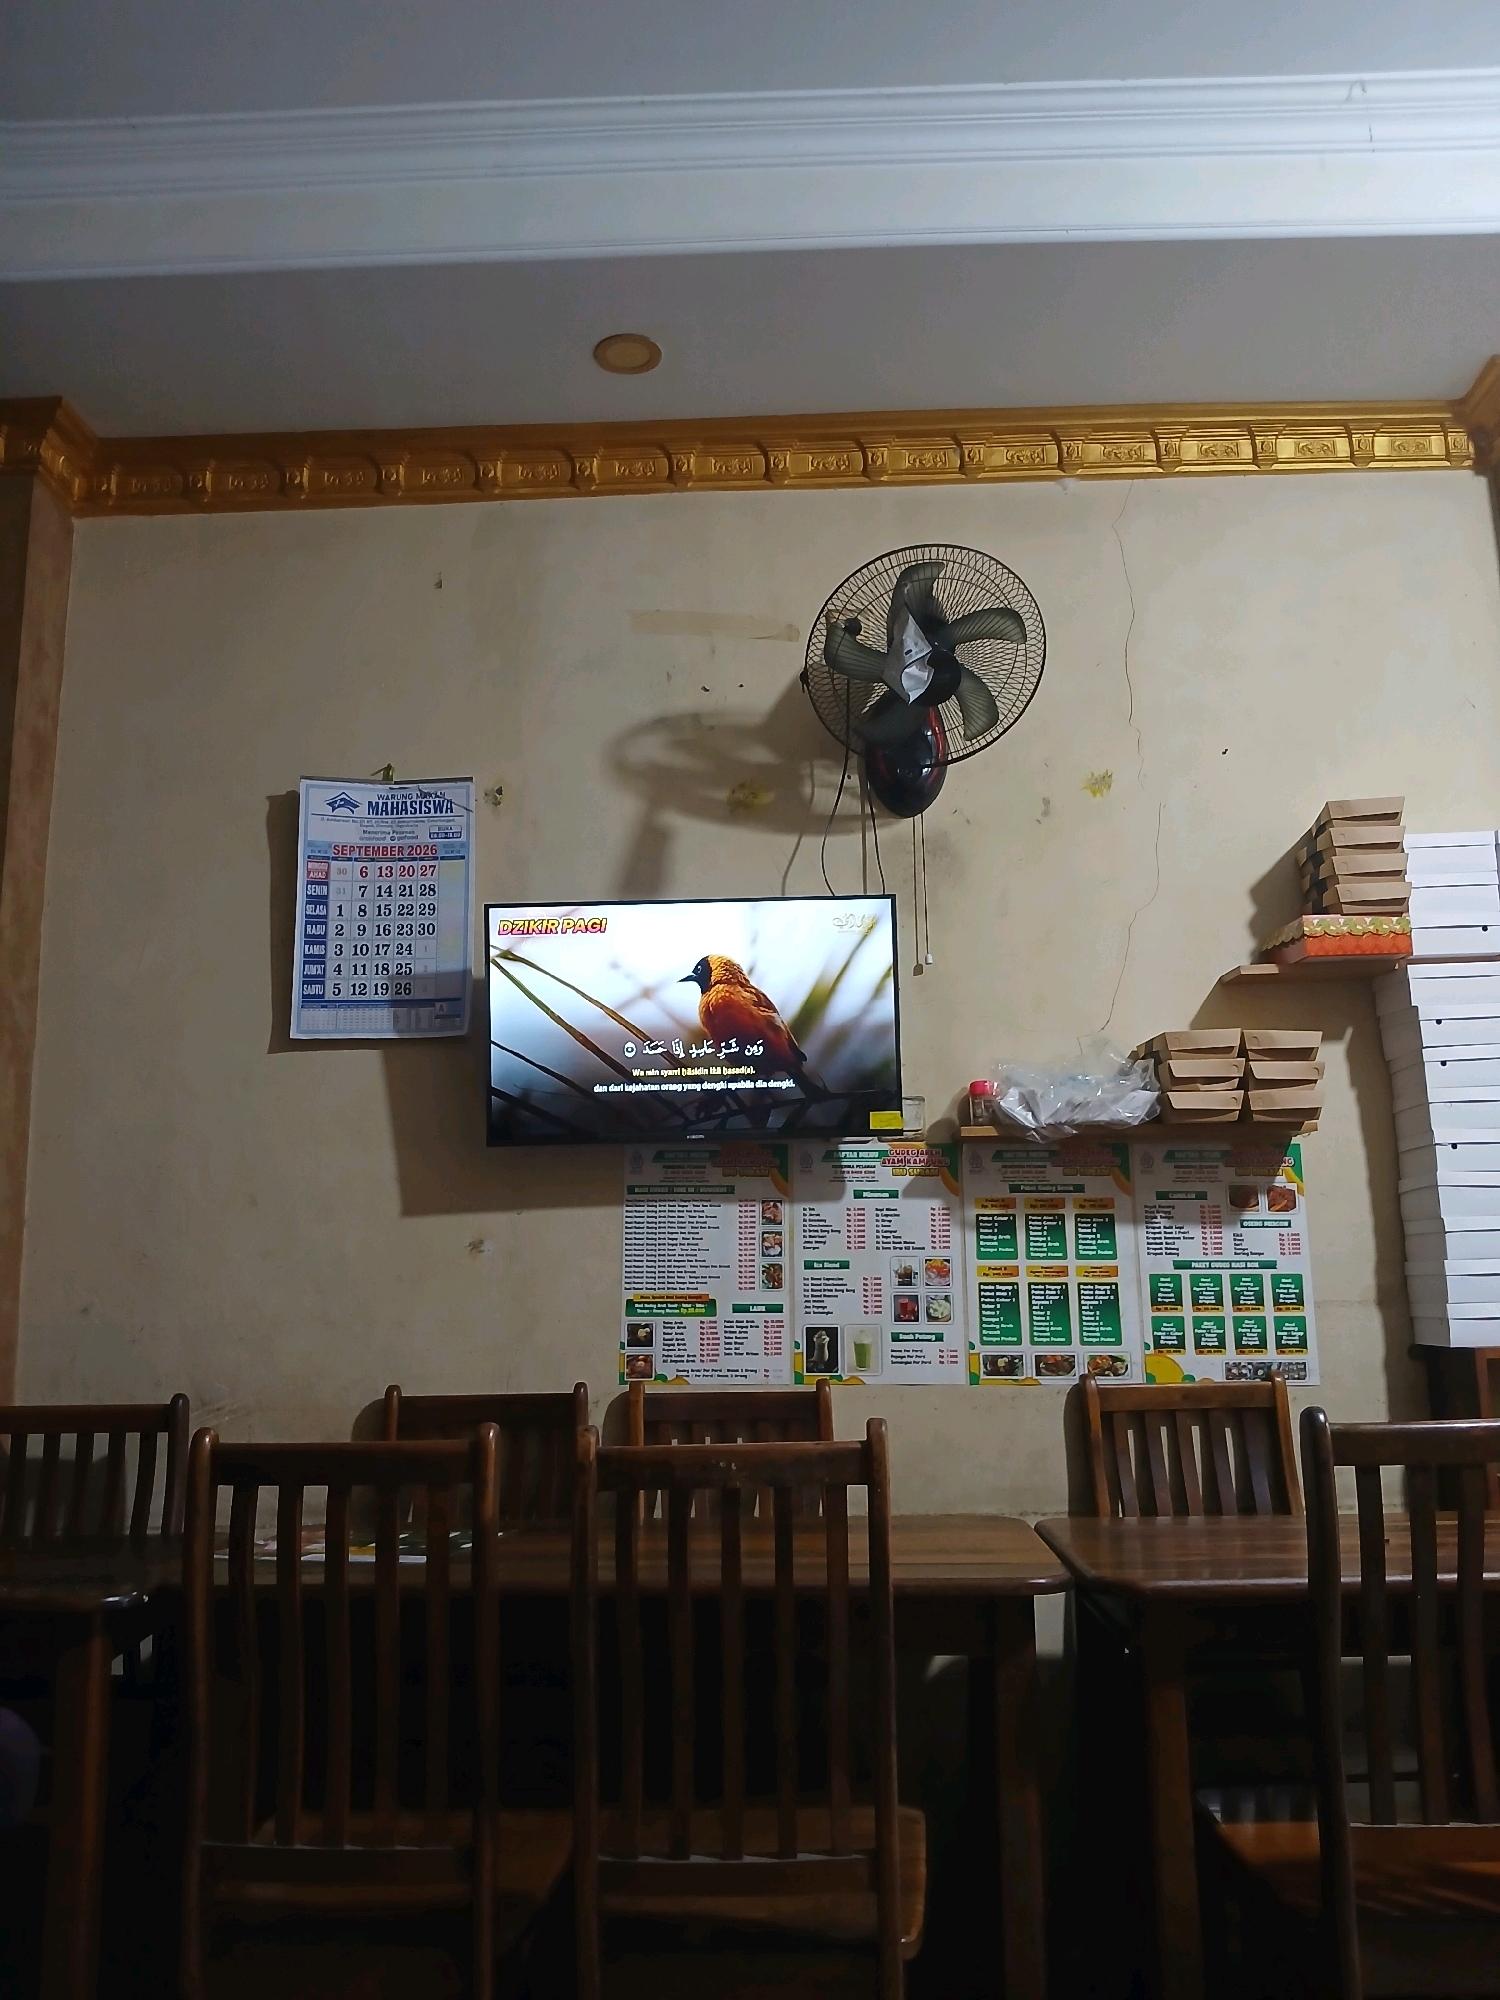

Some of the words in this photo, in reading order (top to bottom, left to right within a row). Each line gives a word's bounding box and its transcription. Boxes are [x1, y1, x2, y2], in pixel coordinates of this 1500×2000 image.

[377, 793, 414, 801] WARUNG
[367, 798, 454, 816] MAHASISWA
[332, 844, 405, 857] SEPTEMBER
[407, 844, 438, 856] 2026
[336, 868, 347, 876] 30
[359, 866, 368, 878] 6
[377, 866, 393, 878] 13
[399, 865, 415, 877] 20
[420, 865, 436, 877] 27
[307, 885, 328, 895] SENIN
[359, 885, 368, 897] 7
[376, 885, 393, 897] 14
[398, 884, 414, 897] 21
[419, 884, 436, 896] 28
[306, 905, 327, 915] SELASA
[337, 904, 344, 917] 1
[357, 904, 367, 917] 8
[376, 904, 392, 916] 15
[397, 904, 414, 916] 22
[418, 903, 436, 916] 29
[335, 924, 344, 936] 2
[357, 924, 366, 937] 9
[375, 924, 391, 936] 16
[397, 923, 414, 936] 23
[418, 922, 435, 935] 30
[498, 919, 560, 935] DZIKIR
[561, 918, 607, 934] PAGI
[304, 945, 325, 955] KAMIS
[334, 943, 343, 956] 3
[352, 943, 369, 956] 10
[374, 943, 390, 956] 17
[395, 943, 413, 956] 24
[333, 963, 342, 976] 4
[351, 963, 368, 976] 11
[374, 963, 390, 976] 18
[395, 962, 412, 975] 25
[332, 983, 341, 996] 5
[350, 983, 367, 996] 12
[373, 982, 390, 995] 19
[394, 982, 412, 995] 26
[593, 1083, 608, 1093] dan
[609, 1083, 624, 1092] dari
[881, 1156, 904, 1165] AYAM
